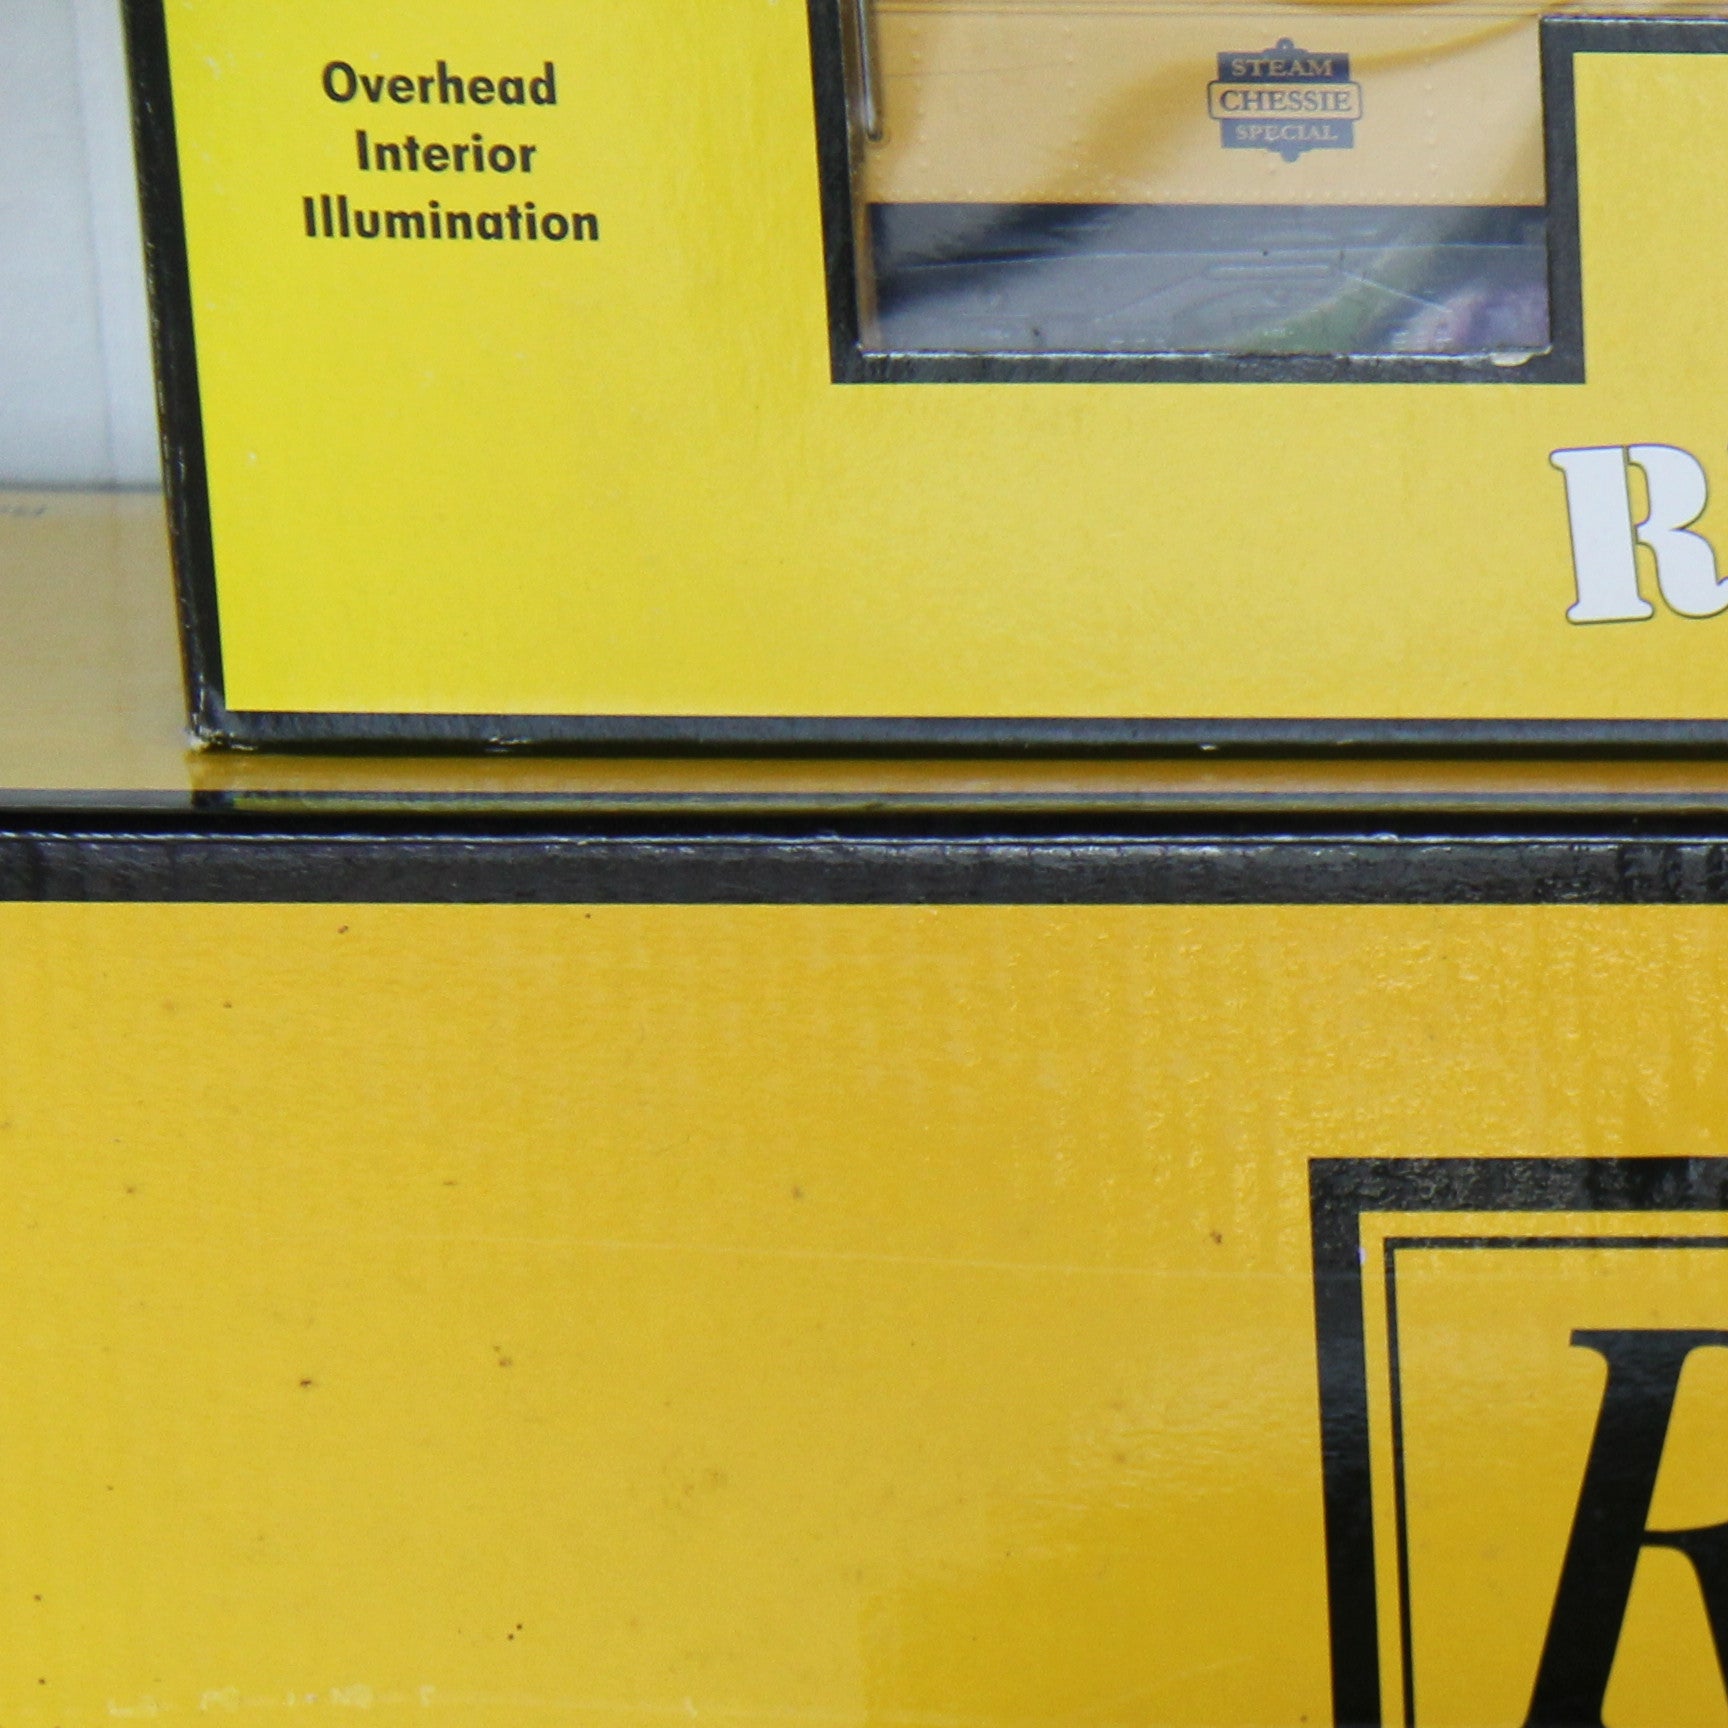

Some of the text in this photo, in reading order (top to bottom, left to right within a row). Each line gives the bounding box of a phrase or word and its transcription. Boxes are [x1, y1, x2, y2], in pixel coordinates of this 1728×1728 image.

[322, 60, 557, 105] Overhead
[1231, 58, 1335, 77] STEAM
[1219, 90, 1353, 112] CHESSIE
[1235, 124, 1339, 141] SPECIAL
[355, 128, 537, 173] Interior
[301, 194, 600, 241] Illumination
